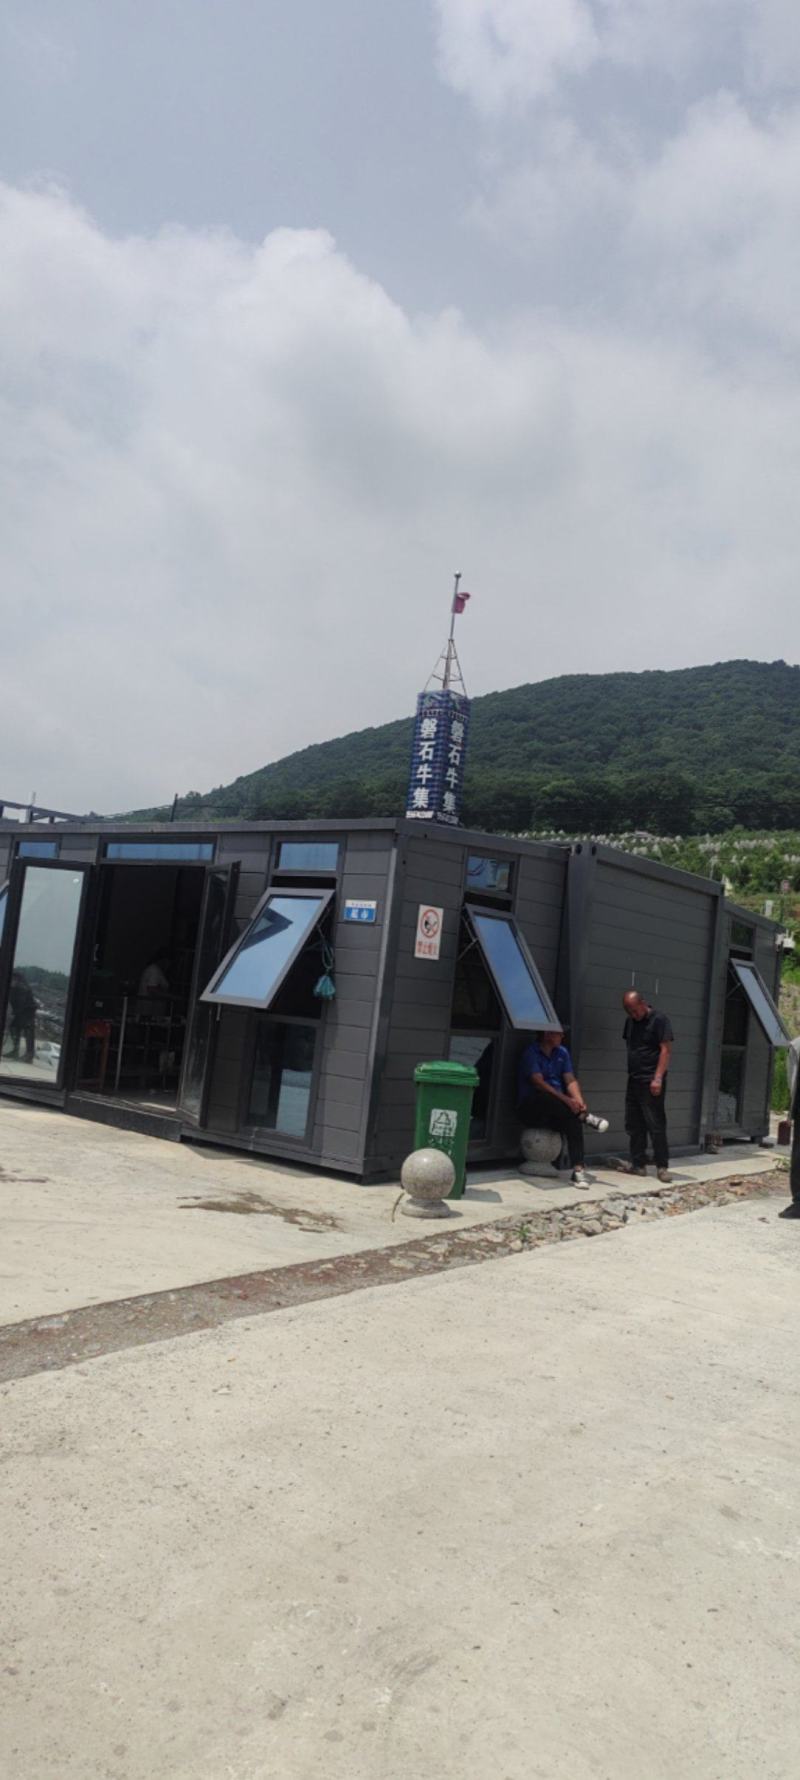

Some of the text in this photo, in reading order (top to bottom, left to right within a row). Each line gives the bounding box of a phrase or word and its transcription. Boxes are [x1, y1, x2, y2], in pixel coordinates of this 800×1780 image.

[412, 718, 438, 809] 磐石牛集
[443, 720, 465, 814] 磐石牛集
